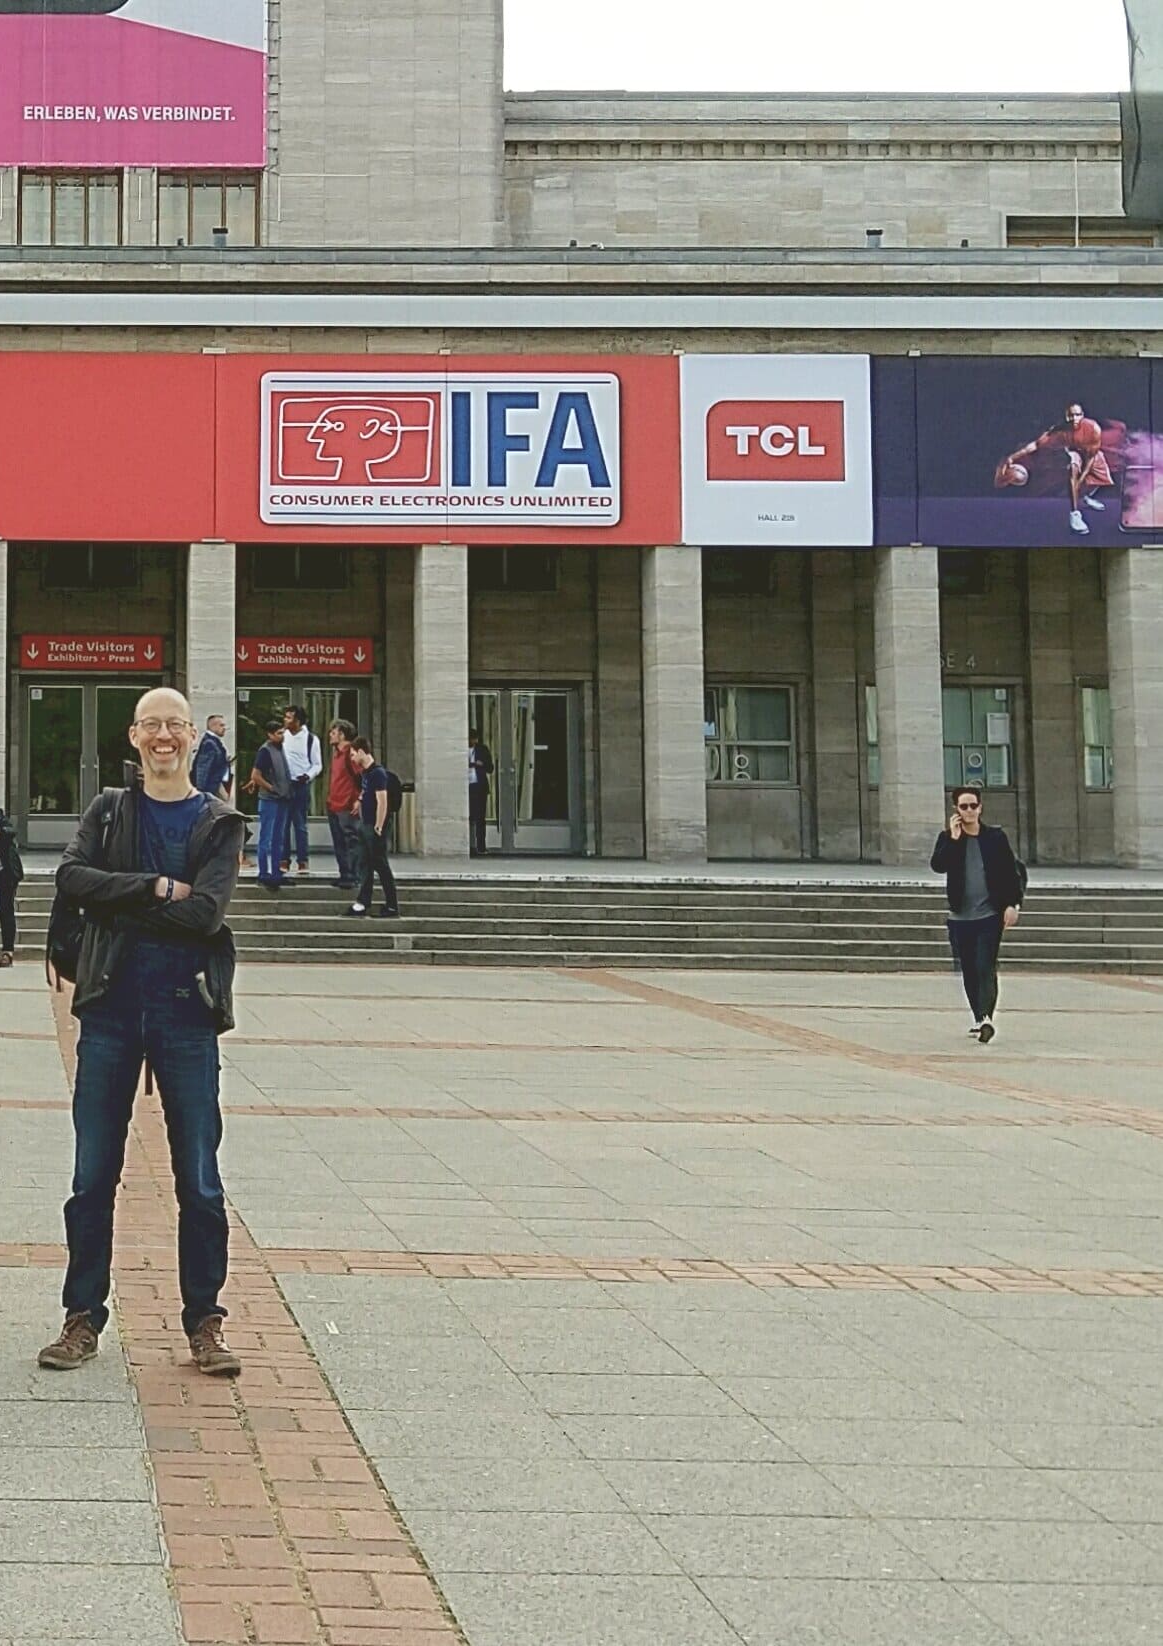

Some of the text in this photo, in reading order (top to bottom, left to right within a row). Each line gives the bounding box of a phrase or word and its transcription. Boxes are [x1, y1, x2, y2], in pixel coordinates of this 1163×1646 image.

[23, 106, 236, 122] ERLEBEN, WAS VERBINDET.
[451, 391, 612, 488] IFA
[725, 425, 826, 457] TCL
[270, 494, 612, 508] CONSUMER ELECTRONICS UNLIMITED
[757, 514, 779, 522] HALL
[48, 641, 135, 652] Trade Visitors
[258, 643, 345, 655] Trade Visitors
[47, 654, 98, 662] Exhibitors
[257, 655, 345, 665] Exhibitors Press
